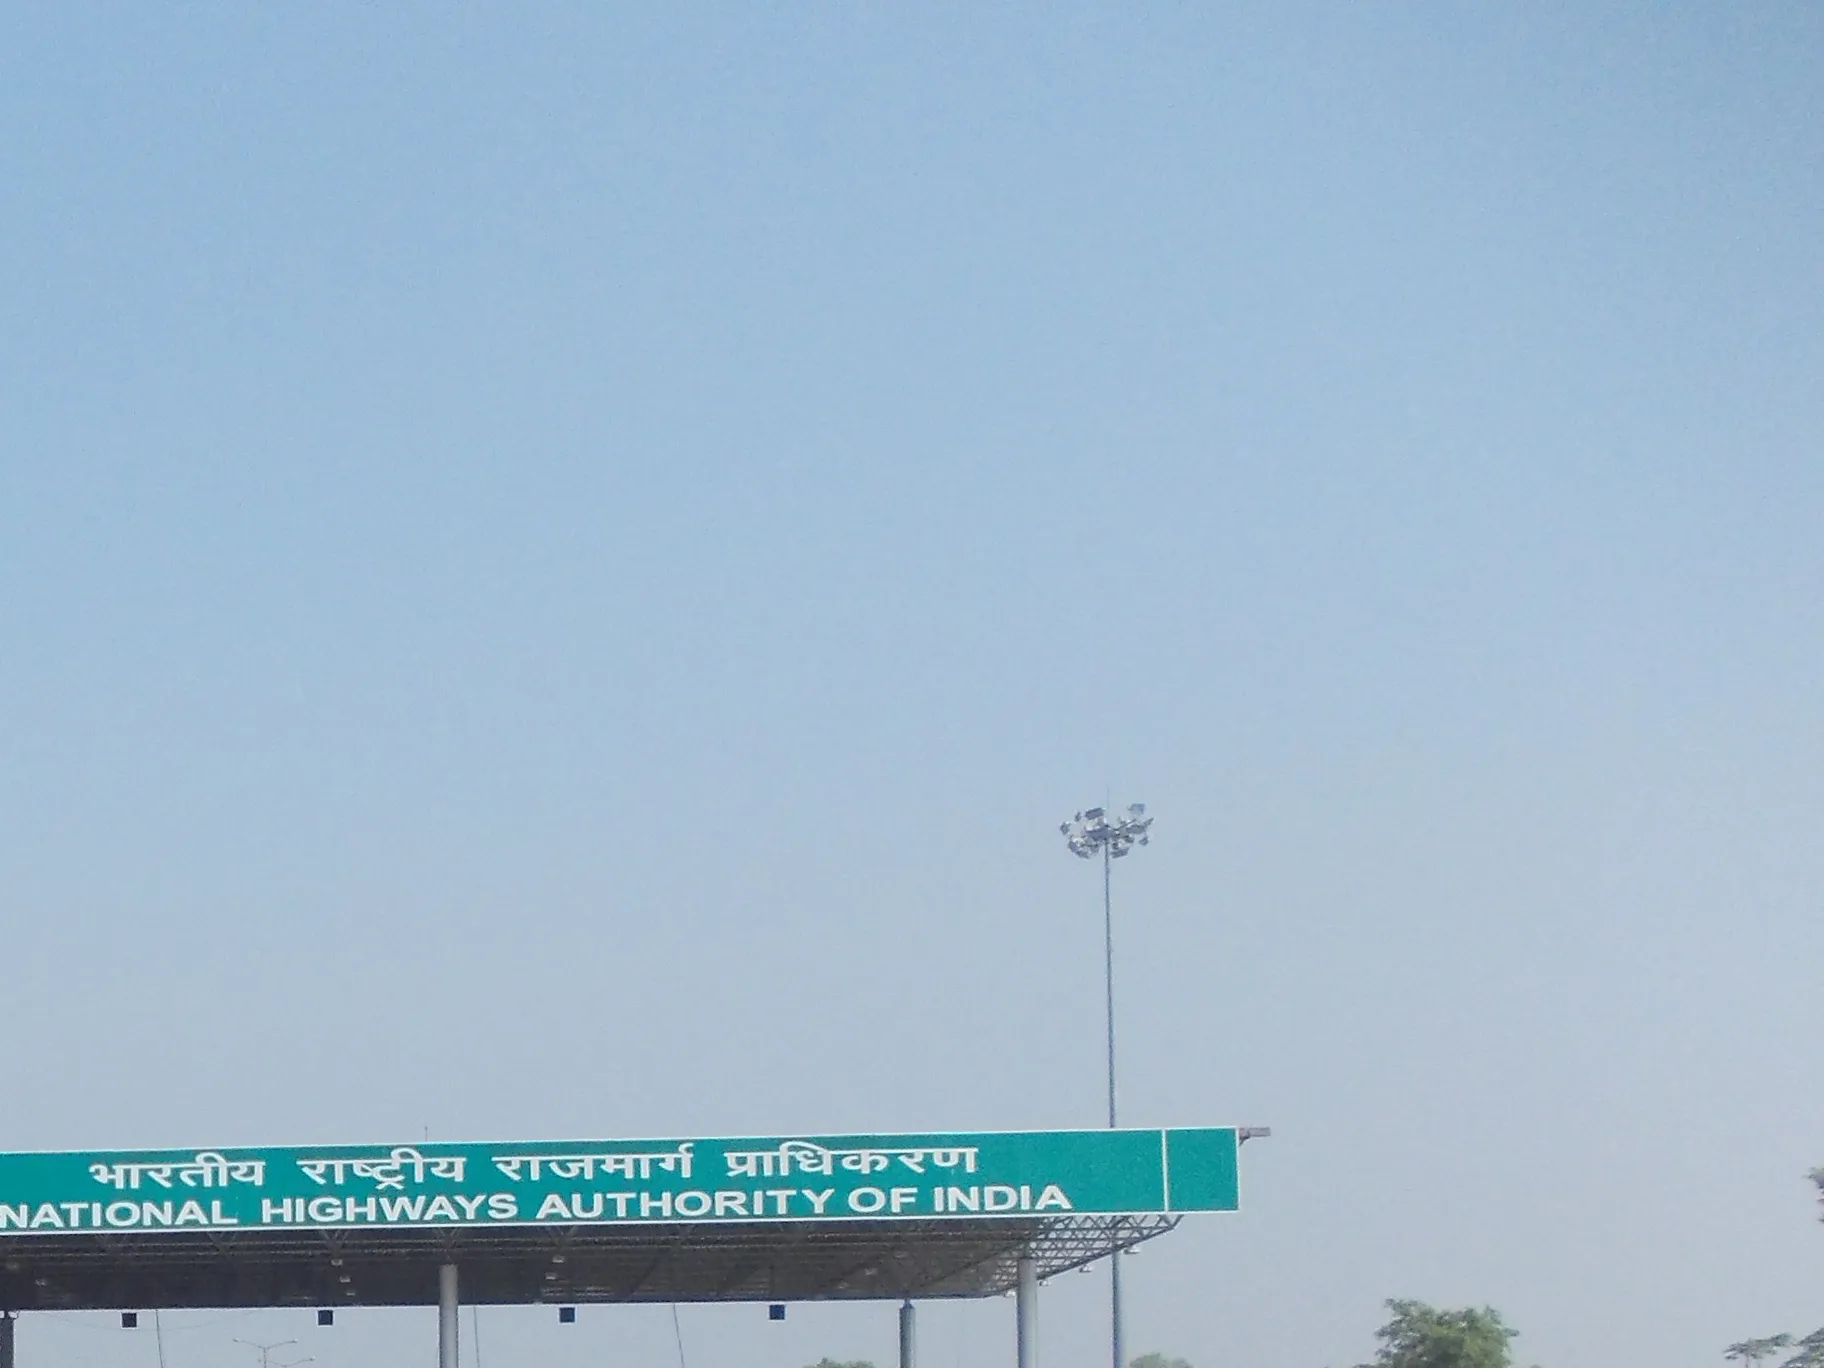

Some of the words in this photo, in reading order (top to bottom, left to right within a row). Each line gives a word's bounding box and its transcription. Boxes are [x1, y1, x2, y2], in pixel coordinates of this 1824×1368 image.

[89, 1152, 266, 1189] भारतीय
[295, 1148, 466, 1189] राष्ट्रीय
[491, 1142, 693, 1180] राजमार्ग
[724, 1142, 978, 1177] प्राधिकरण
[262, 1194, 518, 1223] HIGHWAYS
[536, 1188, 838, 1218] AUTHORITY
[849, 1187, 919, 1214] OF
[934, 1185, 1073, 1212] INDIA
